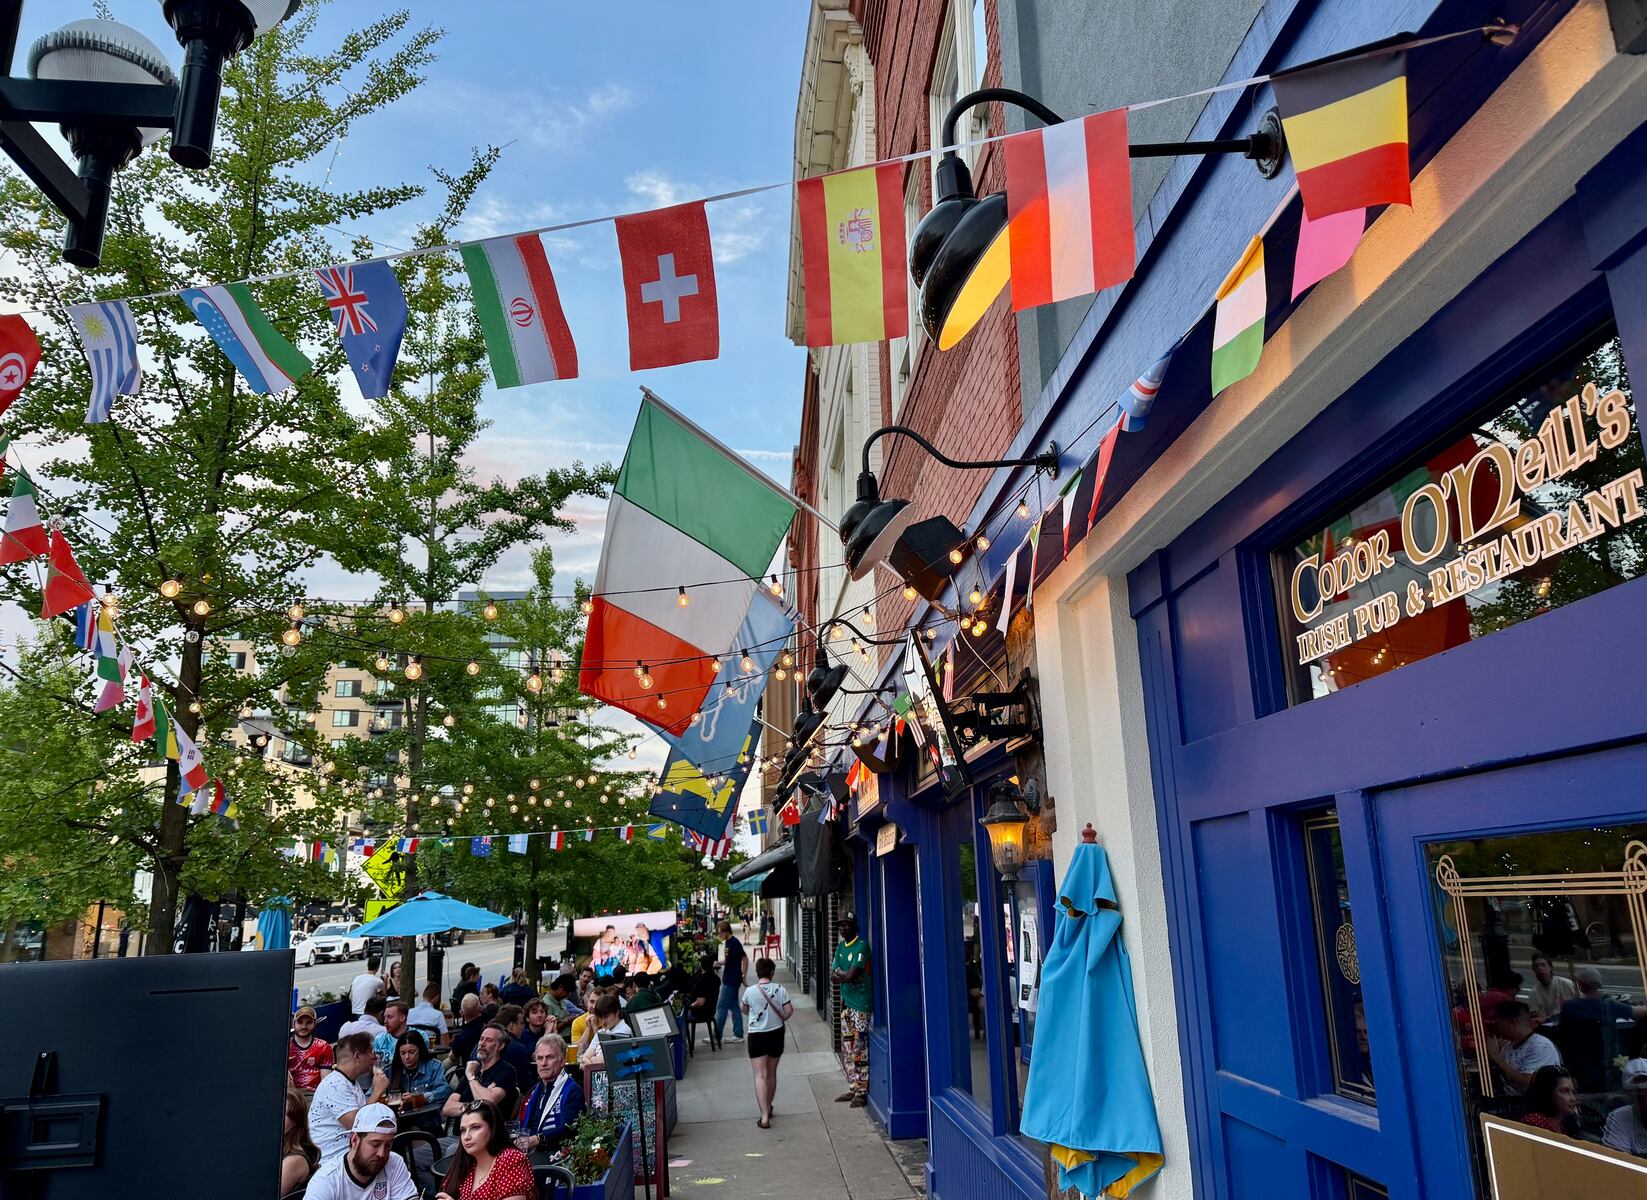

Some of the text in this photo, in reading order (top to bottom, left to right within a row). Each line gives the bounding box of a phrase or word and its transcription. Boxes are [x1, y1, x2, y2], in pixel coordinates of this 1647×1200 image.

[1296, 468, 1644, 665] IRISH PUB & RESTAURANT
[1401, 382, 1631, 565] O'Neill's
